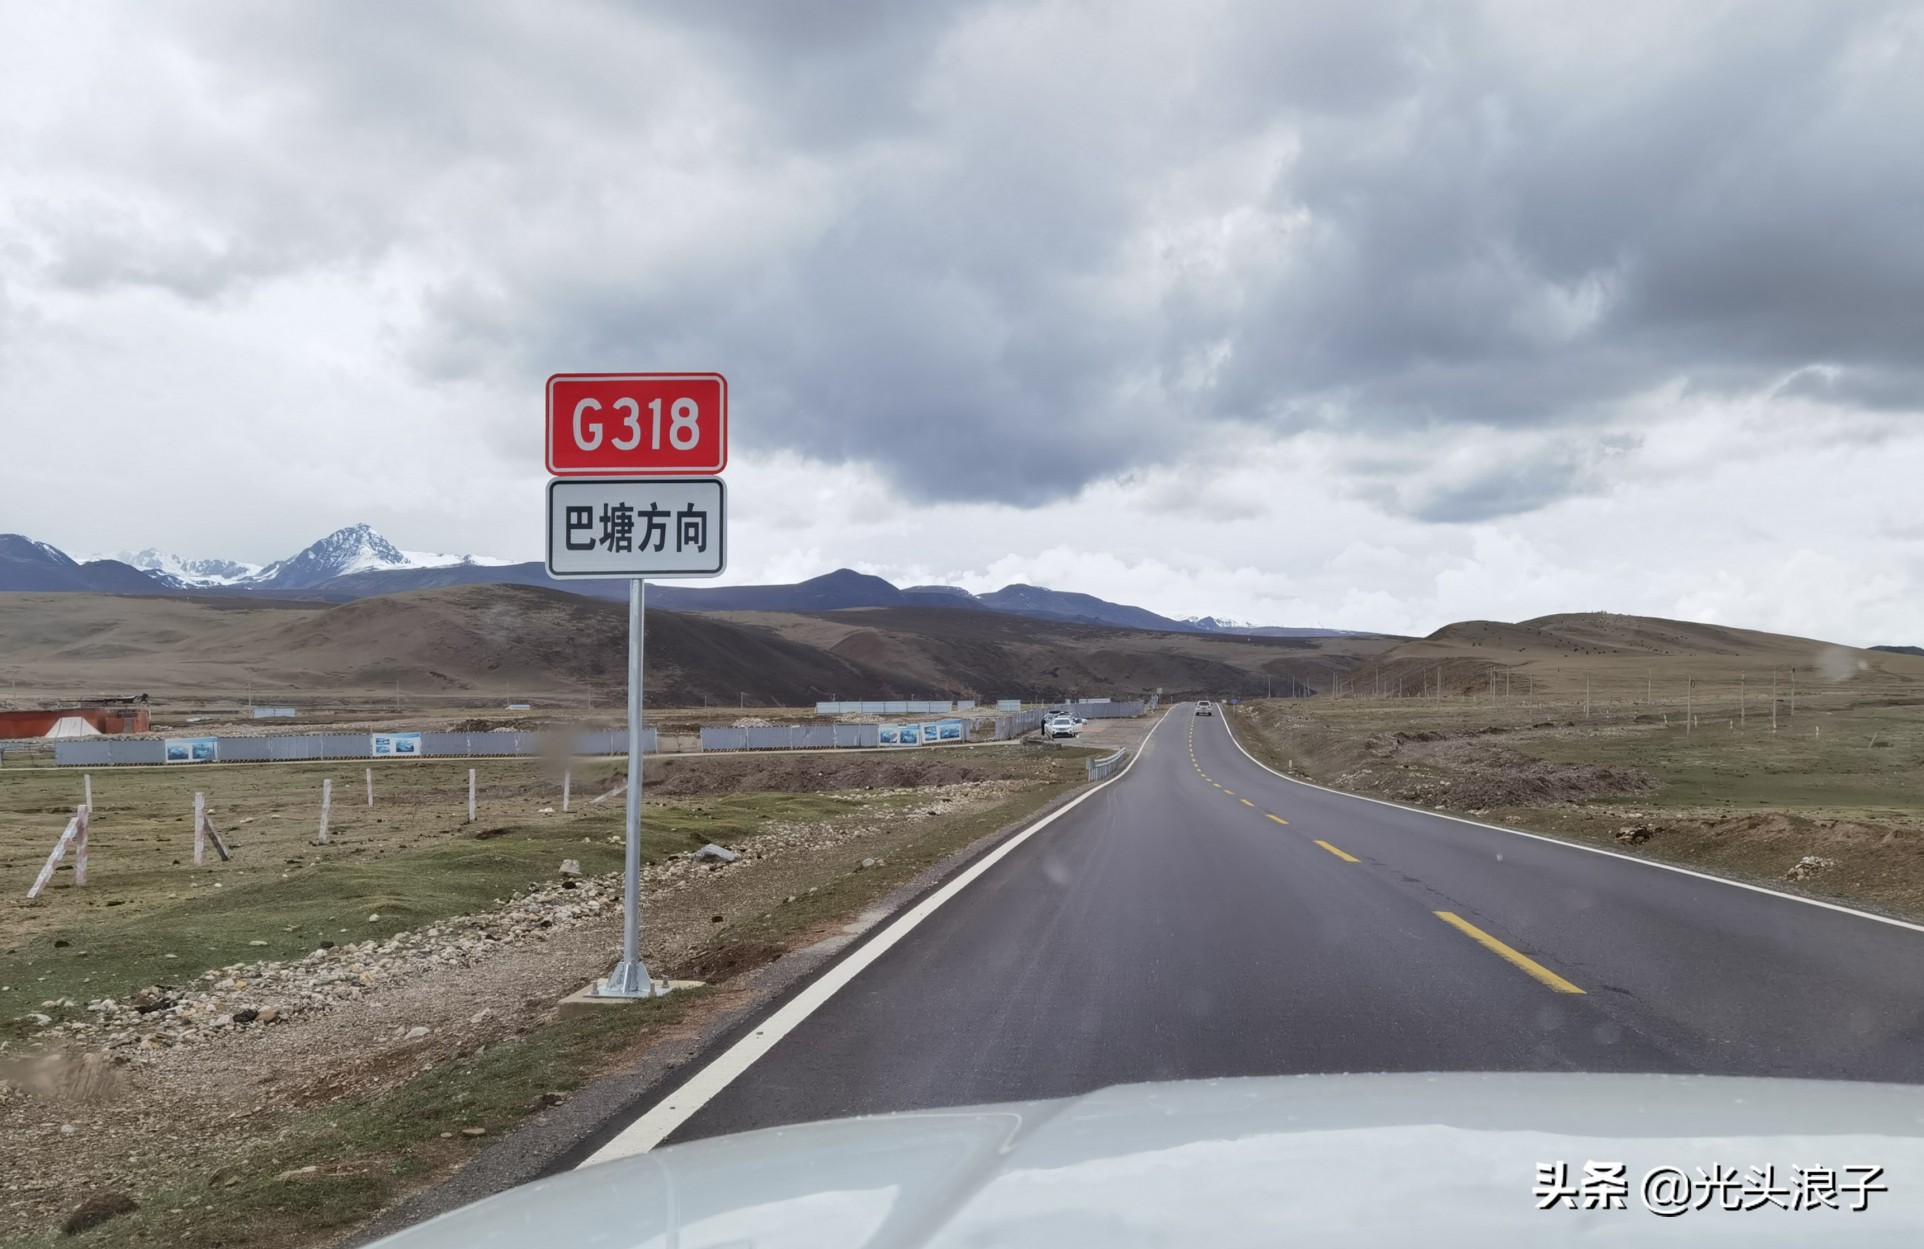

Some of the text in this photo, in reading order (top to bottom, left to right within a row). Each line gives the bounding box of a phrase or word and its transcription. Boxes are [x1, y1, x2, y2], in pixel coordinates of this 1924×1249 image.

[573, 397, 700, 451] G318
[565, 502, 708, 553] 巴塘方向
